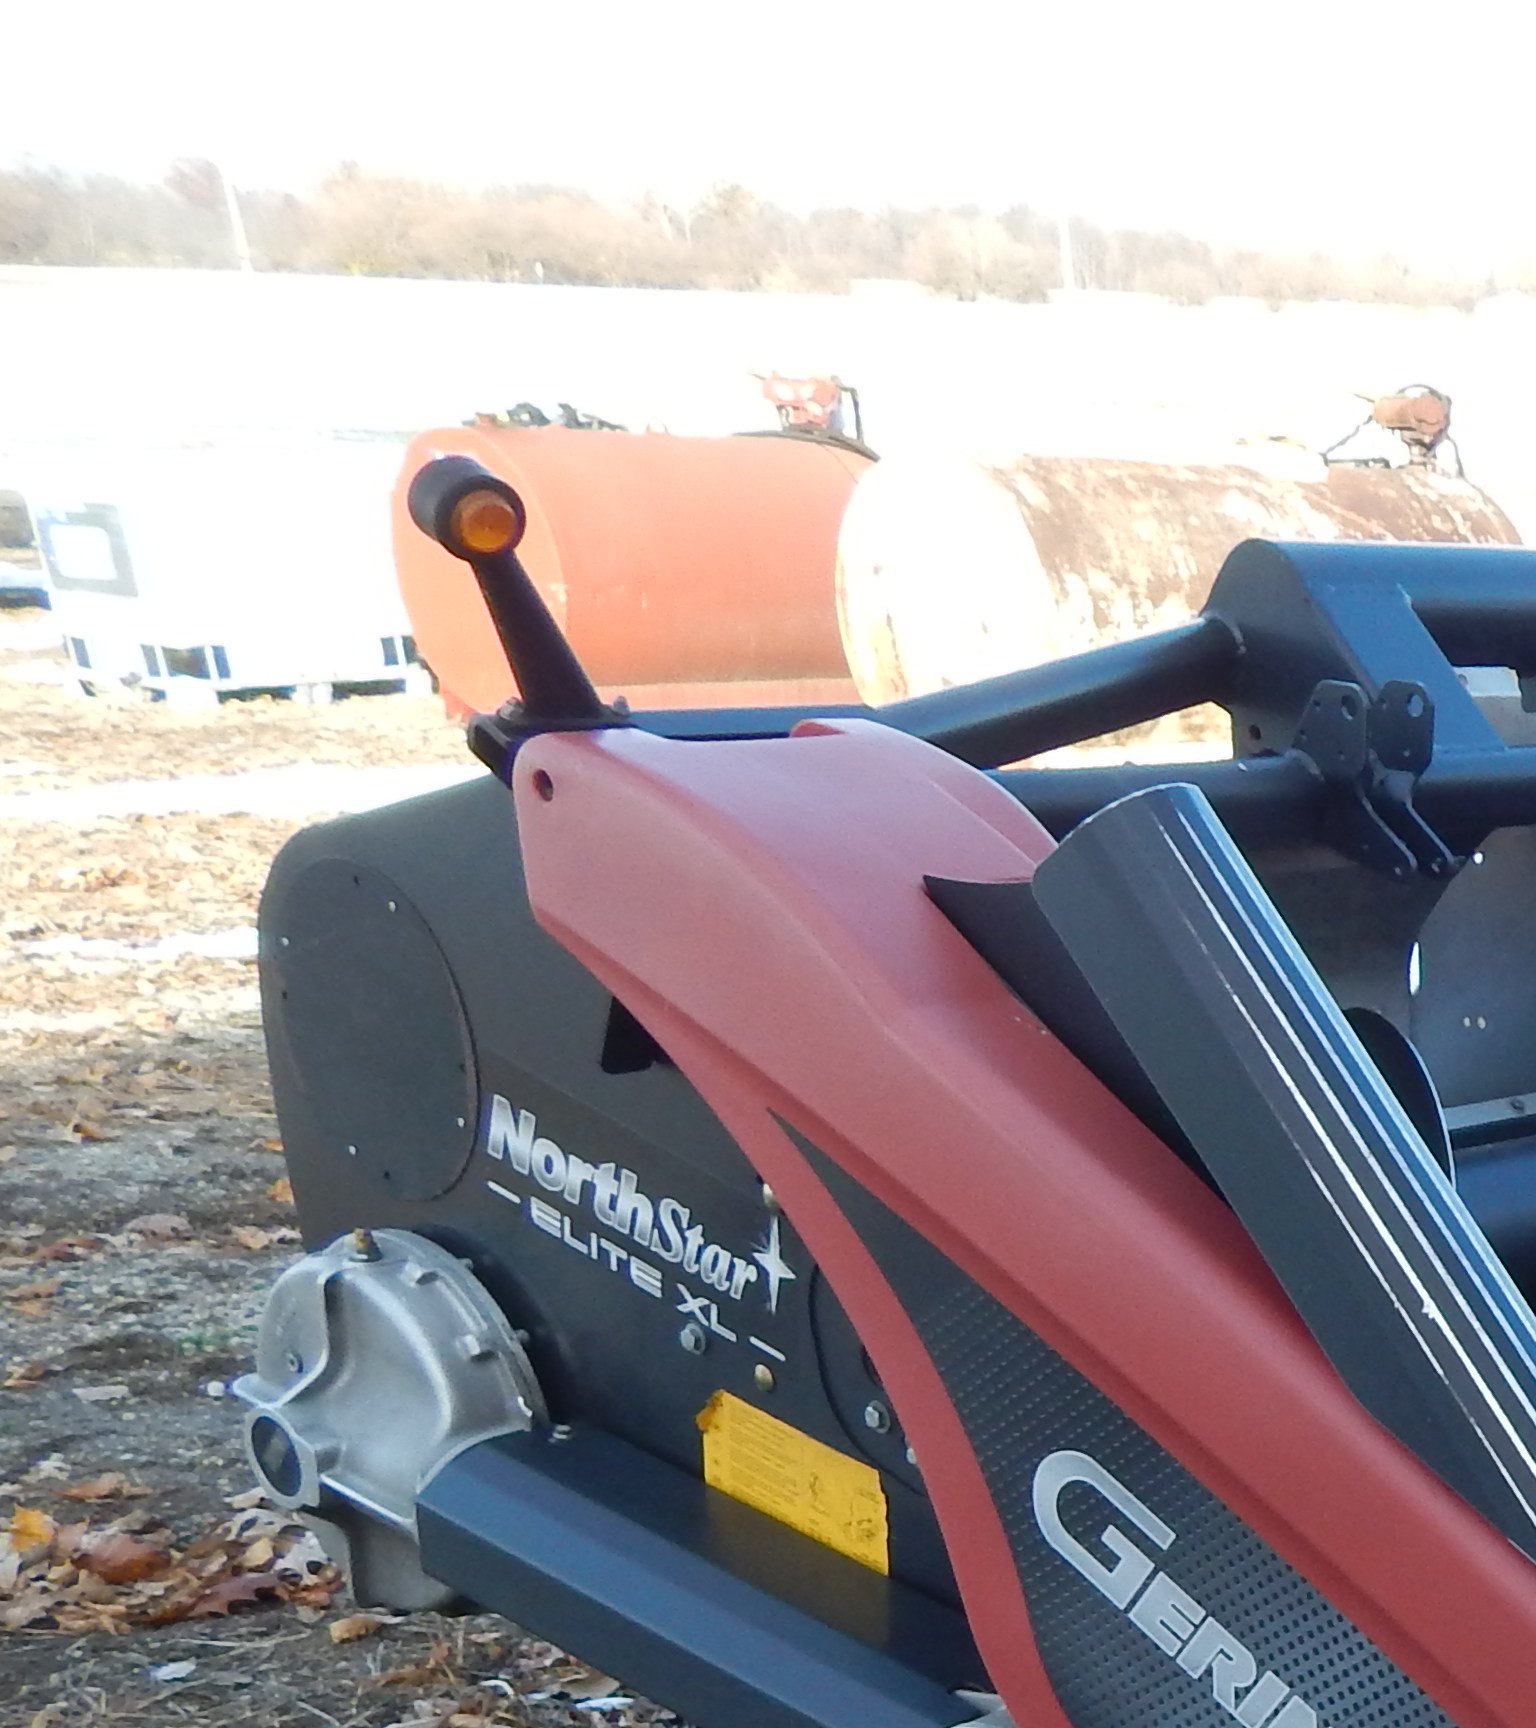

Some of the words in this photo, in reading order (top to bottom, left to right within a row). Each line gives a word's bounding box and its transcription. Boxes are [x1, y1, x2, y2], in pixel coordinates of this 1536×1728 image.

[487, 1094, 758, 1300] NorthStar
[530, 1196, 662, 1299] ELITE
[676, 1282, 737, 1343] XL
